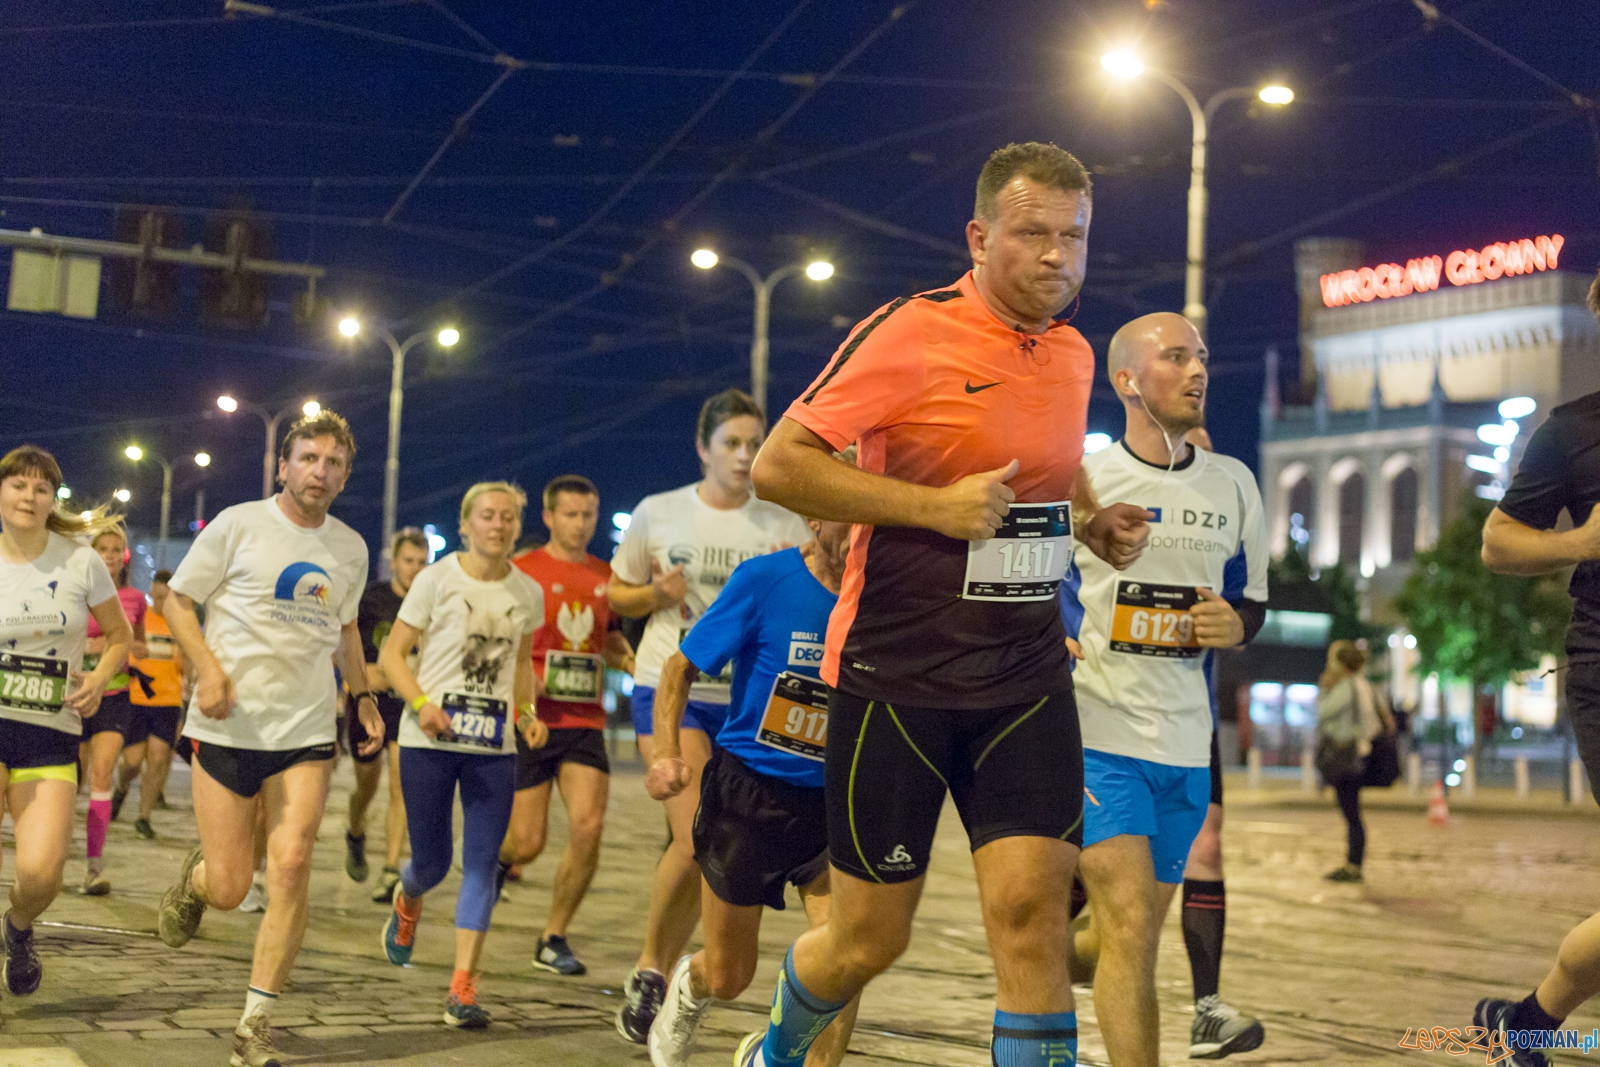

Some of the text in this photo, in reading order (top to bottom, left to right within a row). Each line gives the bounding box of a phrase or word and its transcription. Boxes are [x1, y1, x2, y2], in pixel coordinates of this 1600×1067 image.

[1182, 508, 1228, 530] DZP
[1150, 535, 1226, 553] portteam
[998, 541, 1056, 579] 1417
[1130, 610, 1194, 645] 6129
[2, 673, 54, 702] 7286
[451, 711, 496, 739] 4278
[784, 705, 828, 741] 917
